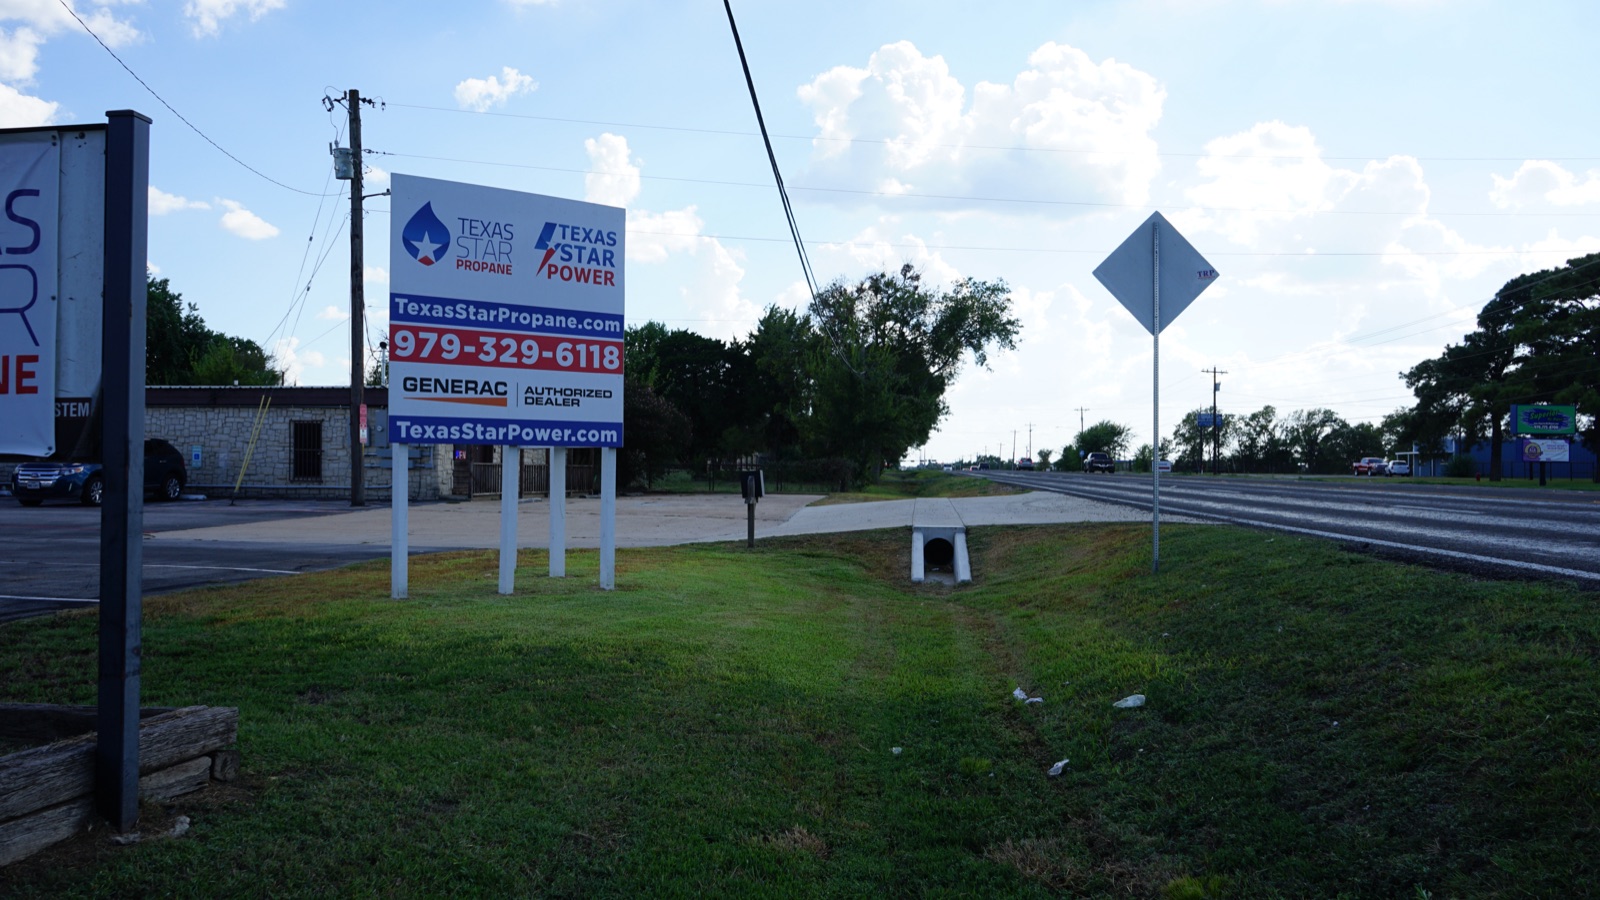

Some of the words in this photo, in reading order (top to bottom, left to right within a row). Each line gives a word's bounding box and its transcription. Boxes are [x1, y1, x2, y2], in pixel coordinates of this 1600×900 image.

[457, 217, 514, 241] TEXAS
[558, 223, 617, 247] TEXAS
[456, 236, 513, 263] STAR
[560, 243, 616, 268] STAR
[456, 259, 513, 276] PROPANE
[547, 263, 616, 287] POWER
[1197, 269, 1215, 278] TRP
[394, 297, 621, 333] TexasStarPropane.com
[394, 330, 620, 370] 979-329-6118
[403, 376, 508, 397] GENERAC
[524, 385, 613, 399] AUTHORIZED
[524, 397, 580, 408] DEALER
[396, 421, 618, 443] TexasStarPower.com
